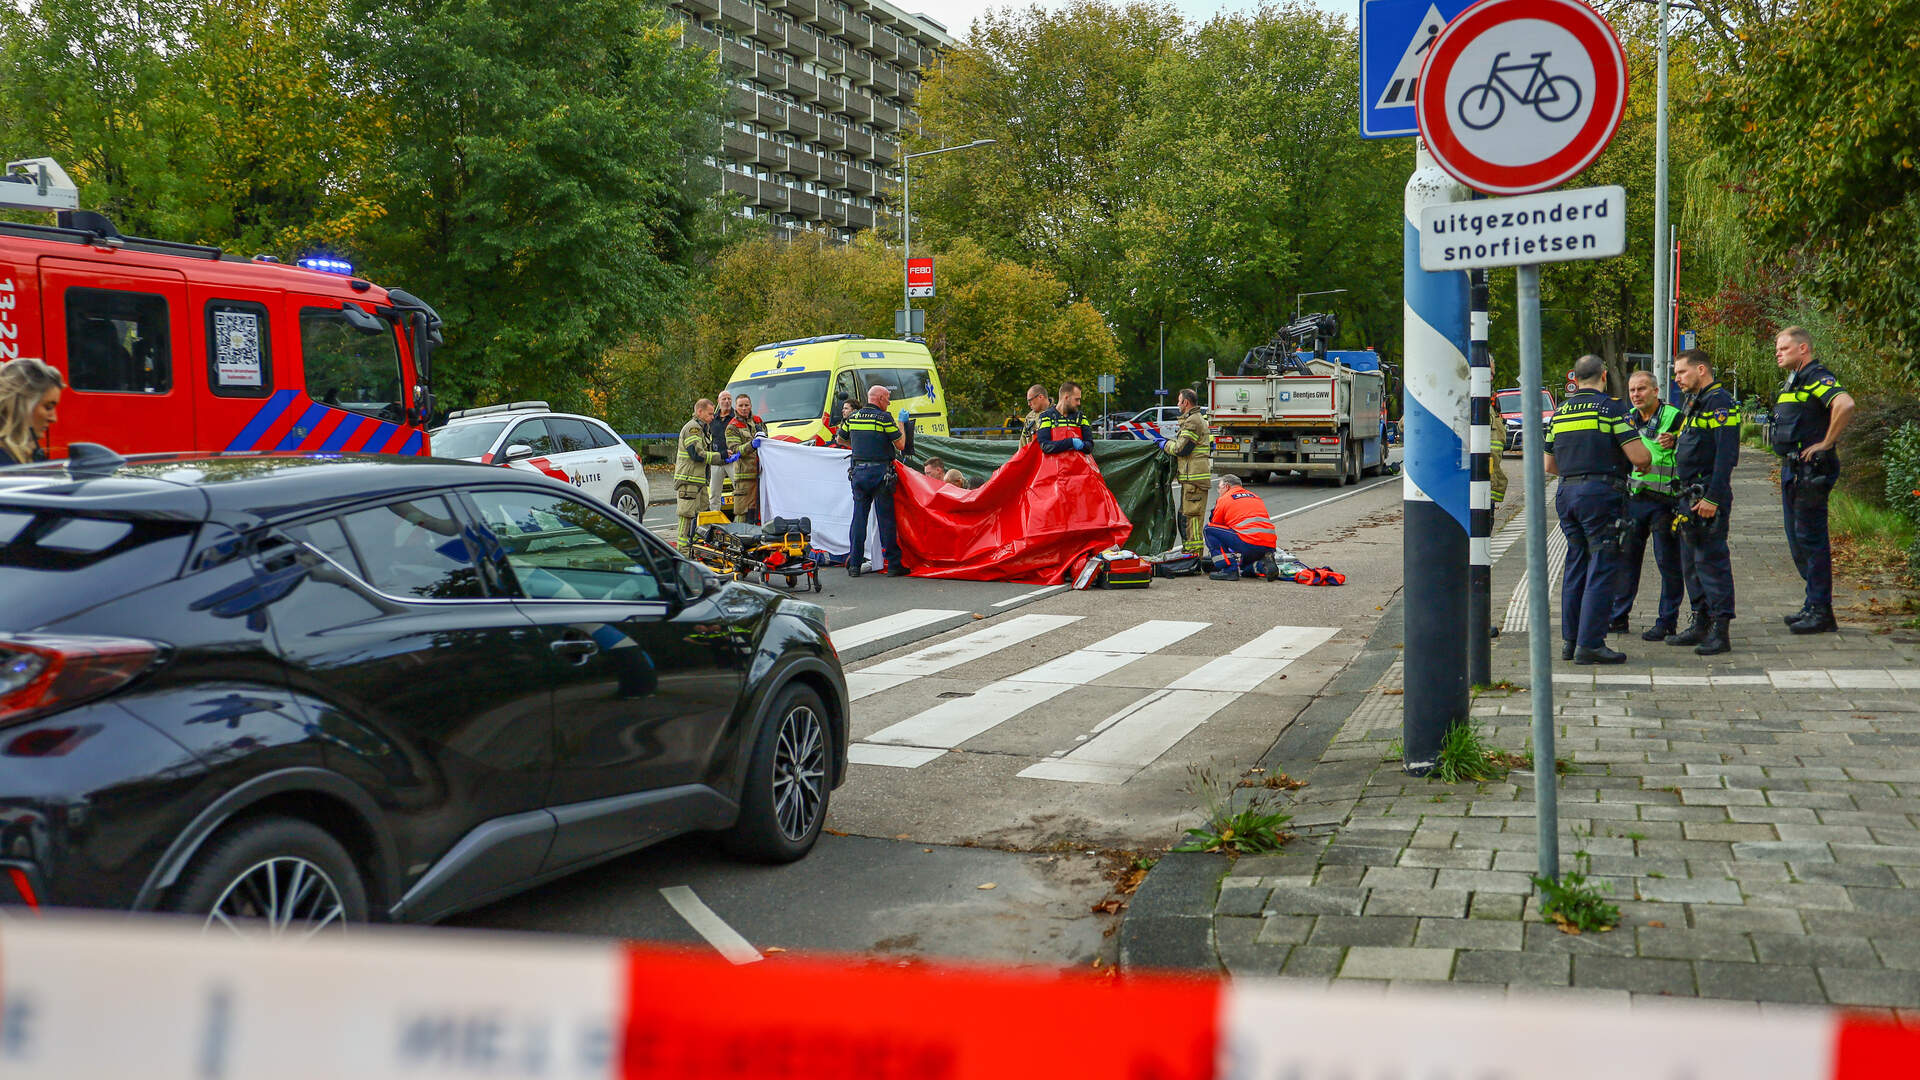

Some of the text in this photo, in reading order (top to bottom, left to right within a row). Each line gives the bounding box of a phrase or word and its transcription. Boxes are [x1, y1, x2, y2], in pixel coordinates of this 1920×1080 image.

[1433, 198, 1608, 236] uitgezonderd
[1444, 234, 1596, 261] snorfietsen
[910, 266, 931, 274] FEBO
[1316, 391, 1330, 399] GWW
[1556, 402, 1593, 414] POLITIE
[571, 472, 601, 487] POLITIE
